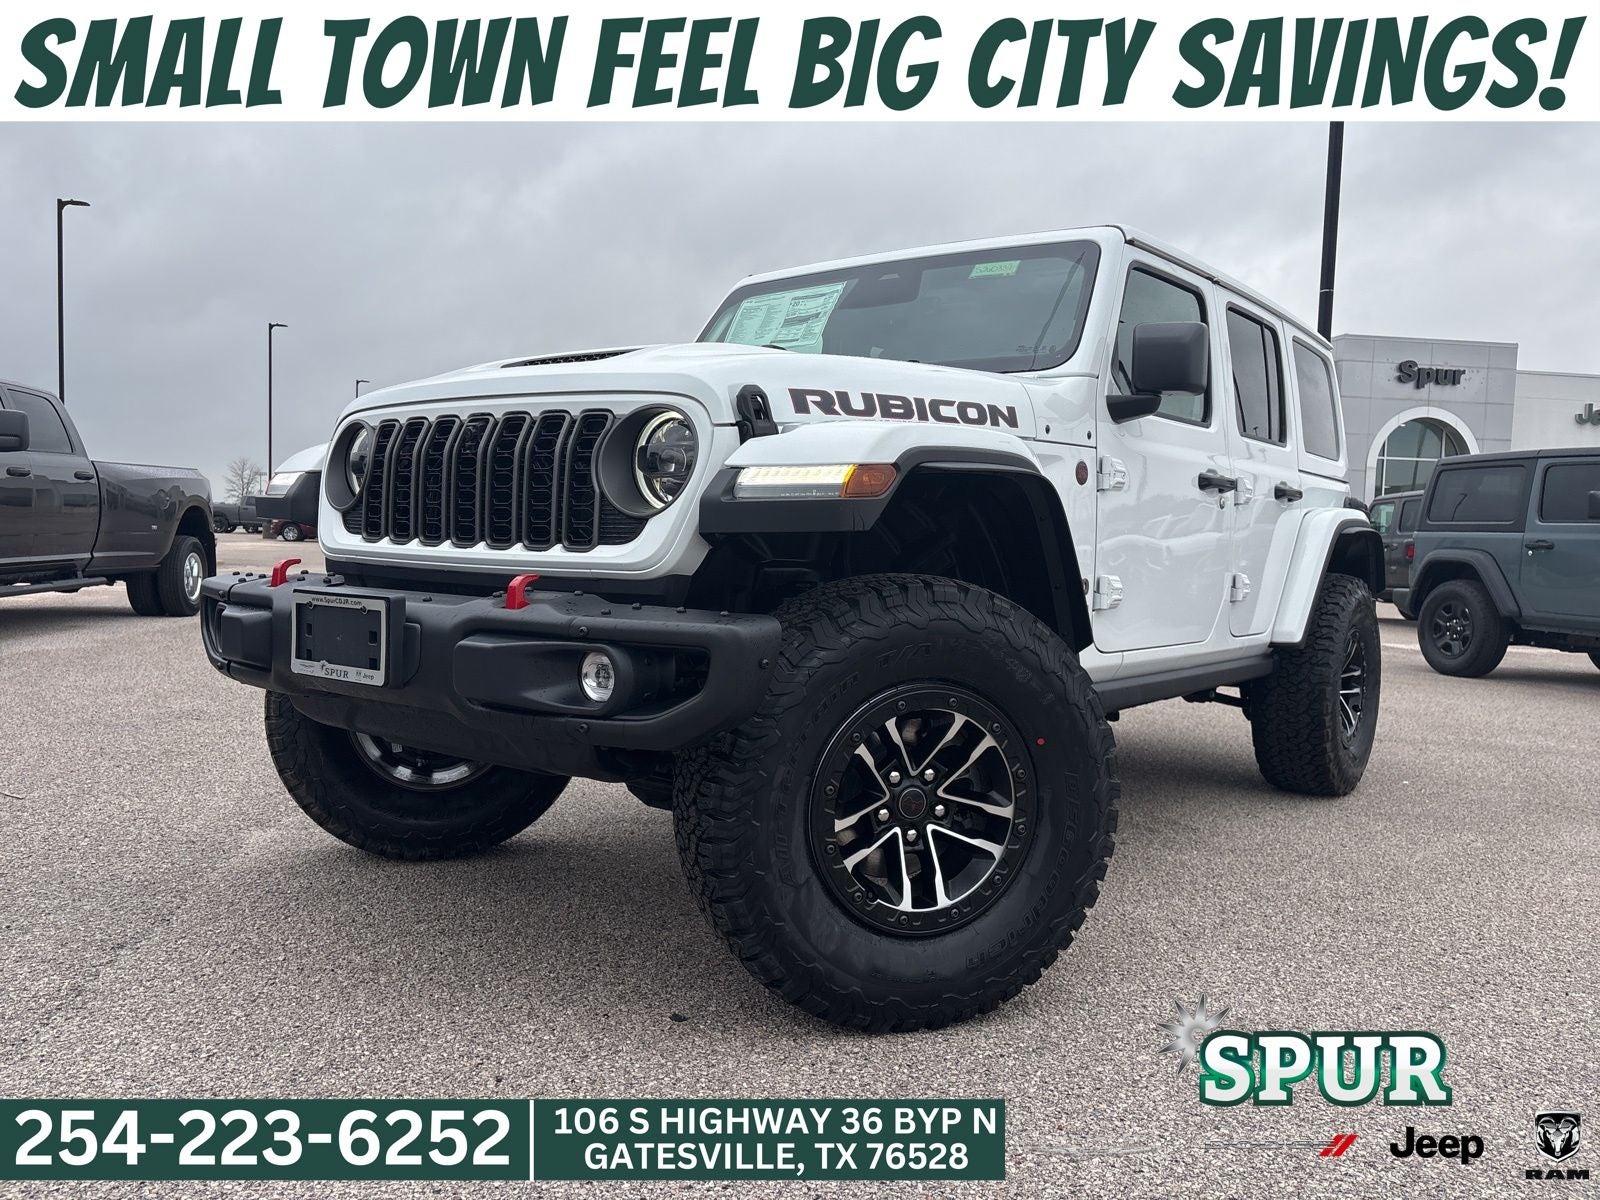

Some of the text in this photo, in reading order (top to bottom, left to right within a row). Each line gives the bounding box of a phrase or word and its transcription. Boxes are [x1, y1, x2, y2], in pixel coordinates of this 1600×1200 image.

[1397, 360, 1466, 389] Spur
[788, 388, 1019, 428] RUBICON
[311, 597, 363, 606] www.SpurCDJR.com
[325, 668, 349, 679] SPUR
